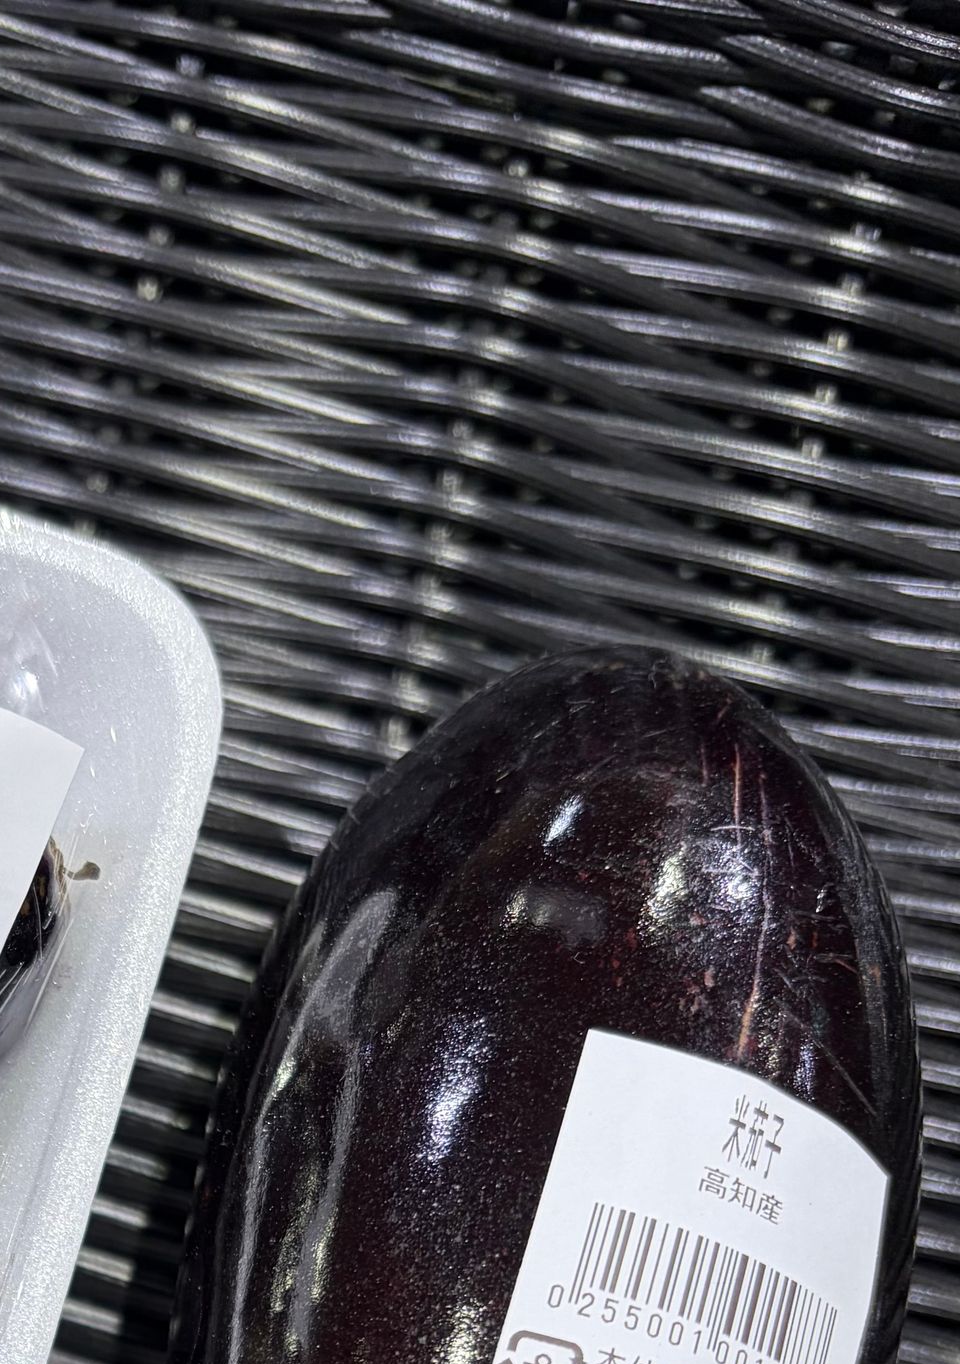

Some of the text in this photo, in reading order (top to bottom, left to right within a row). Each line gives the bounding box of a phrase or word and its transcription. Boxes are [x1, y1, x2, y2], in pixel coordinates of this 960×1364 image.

[721, 1094, 785, 1178] 米茄子
[697, 1165, 784, 1226] 高知産
